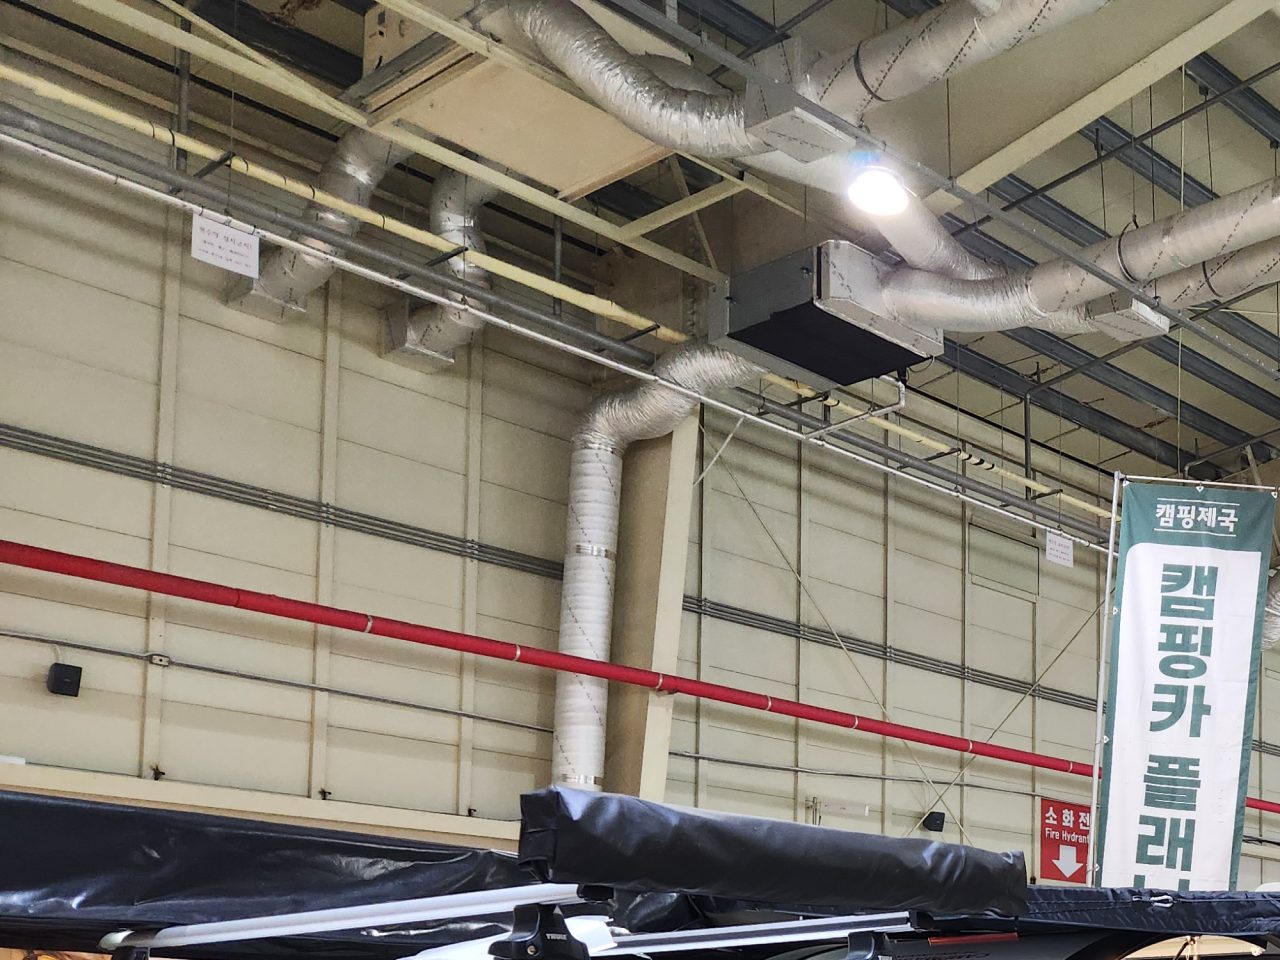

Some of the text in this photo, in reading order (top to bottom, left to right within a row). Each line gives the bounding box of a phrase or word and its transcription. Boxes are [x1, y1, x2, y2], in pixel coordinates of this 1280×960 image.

[1155, 503, 1239, 532] 캠핑제국
[1149, 563, 1218, 739] 캠핑카
[1045, 827, 1060, 840] Fire
